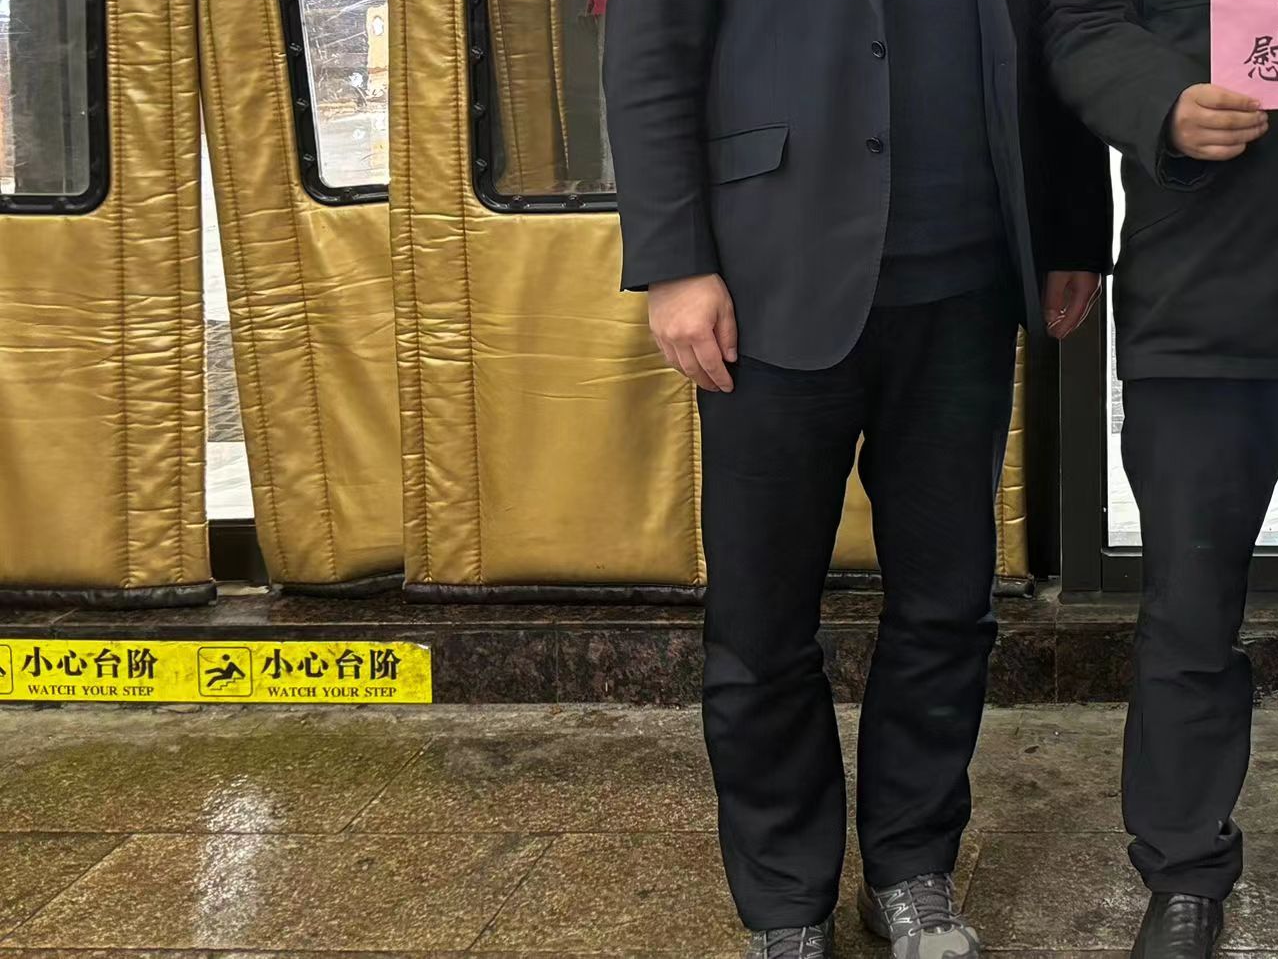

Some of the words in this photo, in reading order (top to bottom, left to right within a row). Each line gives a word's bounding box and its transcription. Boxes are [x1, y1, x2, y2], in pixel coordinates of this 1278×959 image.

[21, 646, 159, 679] 小心台阶
[261, 648, 402, 680] 小心台阶
[28, 684, 76, 696] WATCH
[82, 685, 118, 696] YOUR
[123, 686, 155, 697] STEP
[268, 686, 317, 697] WATCH
[322, 687, 359, 698] YOUR
[364, 687, 397, 698] STEP
